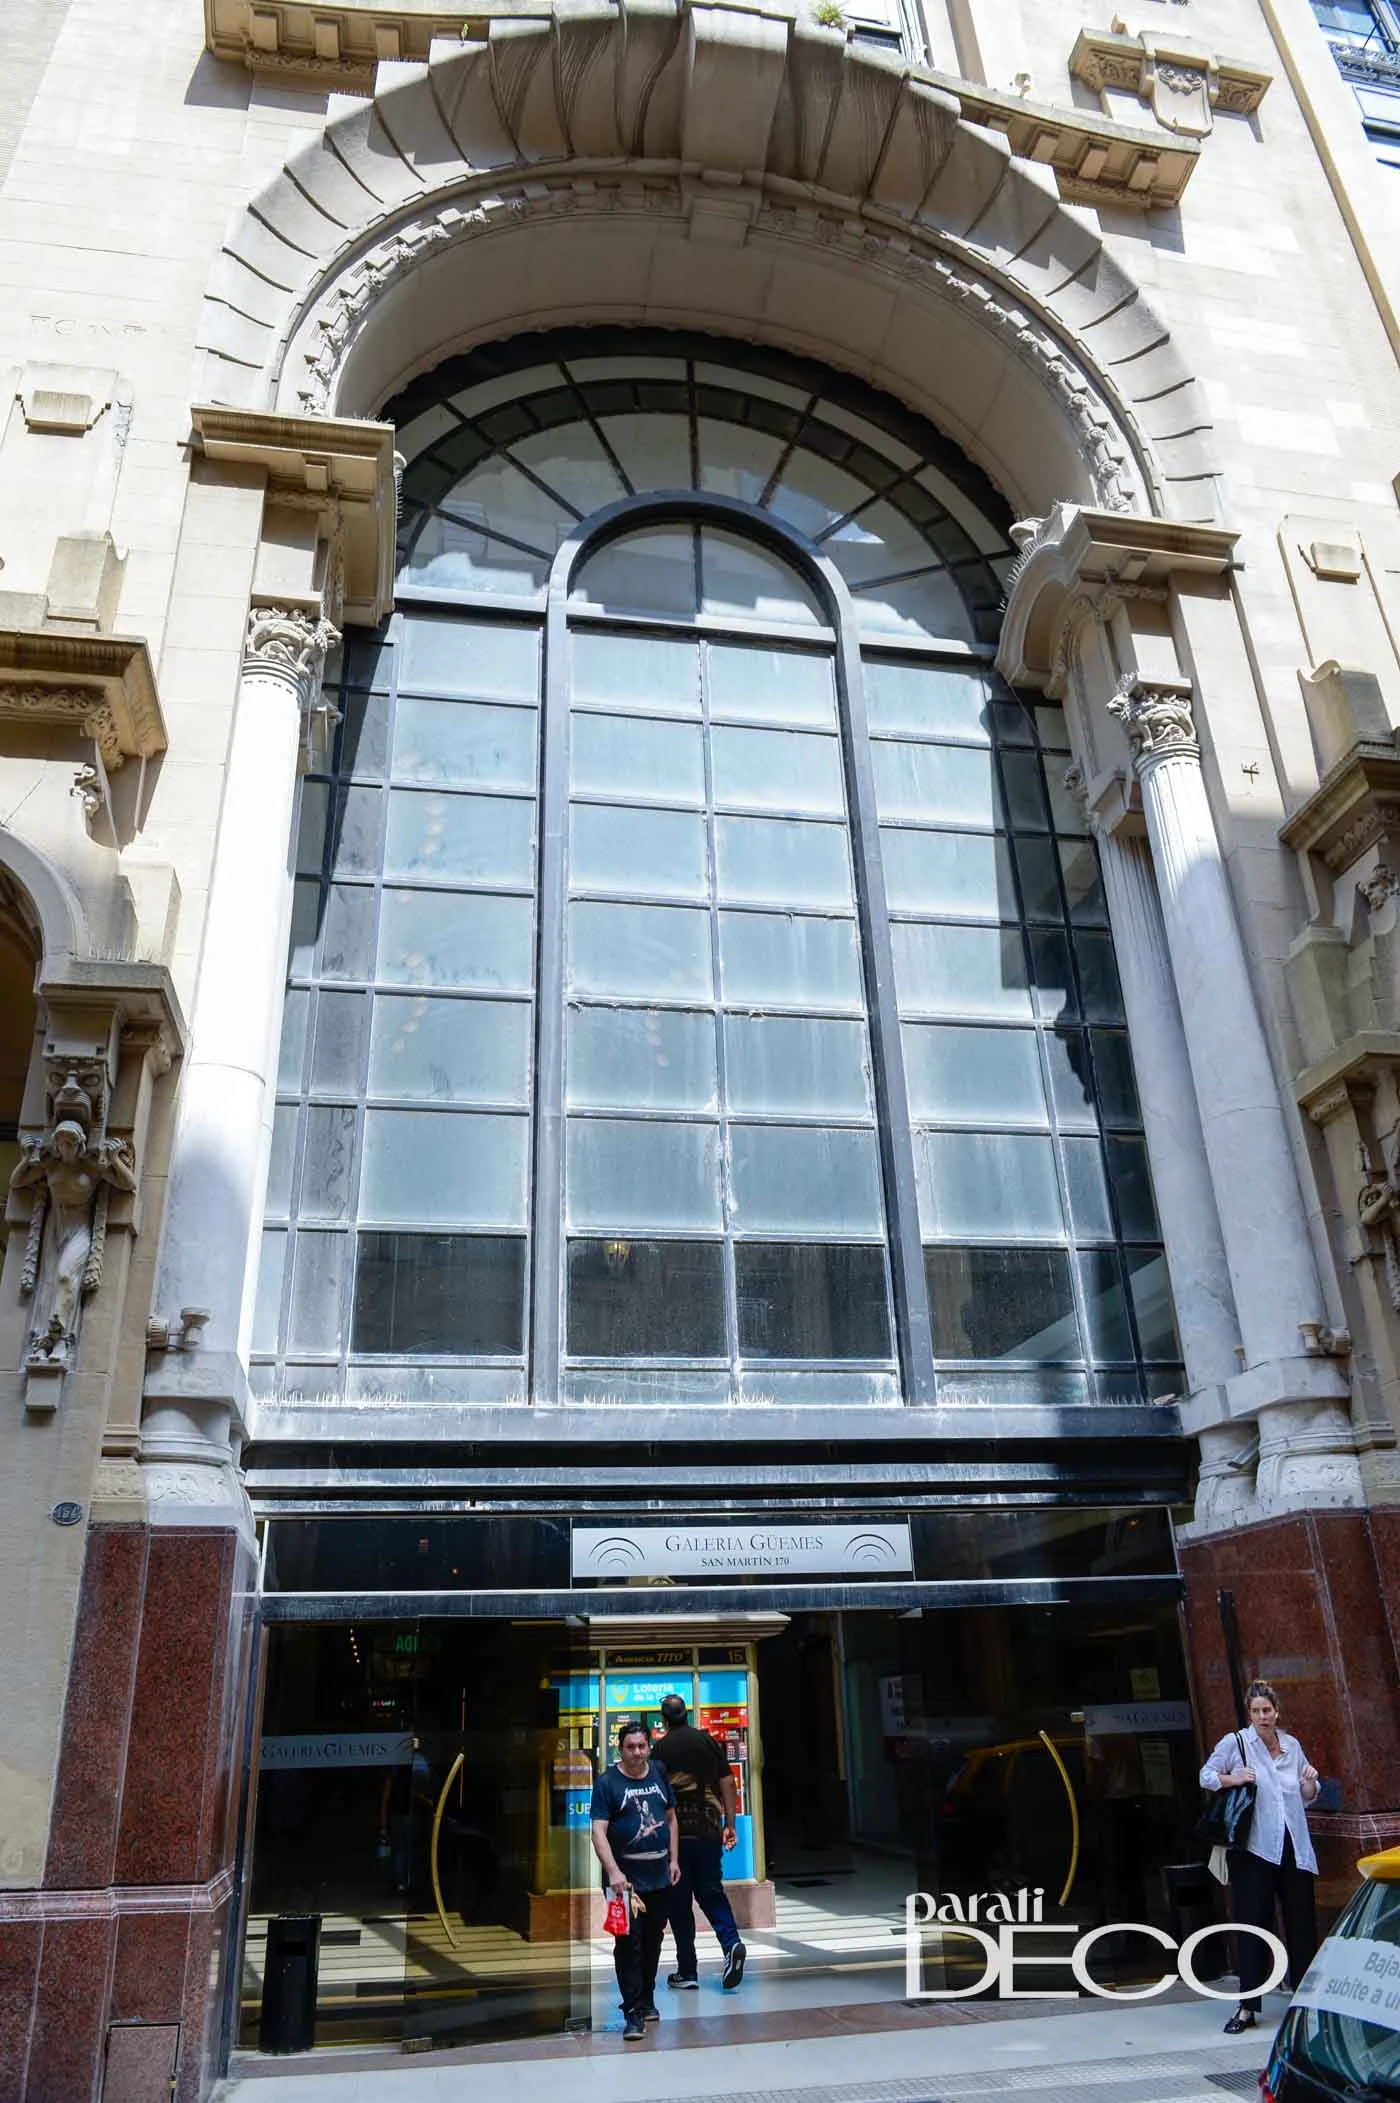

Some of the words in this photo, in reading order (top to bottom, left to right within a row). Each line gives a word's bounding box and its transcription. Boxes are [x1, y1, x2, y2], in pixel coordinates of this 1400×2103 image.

[701, 1557, 723, 1567] SAN
[775, 1556, 790, 1567] 170
[1325, 1976, 1369, 2001] subite
[1370, 1988, 1383, 2005] a
